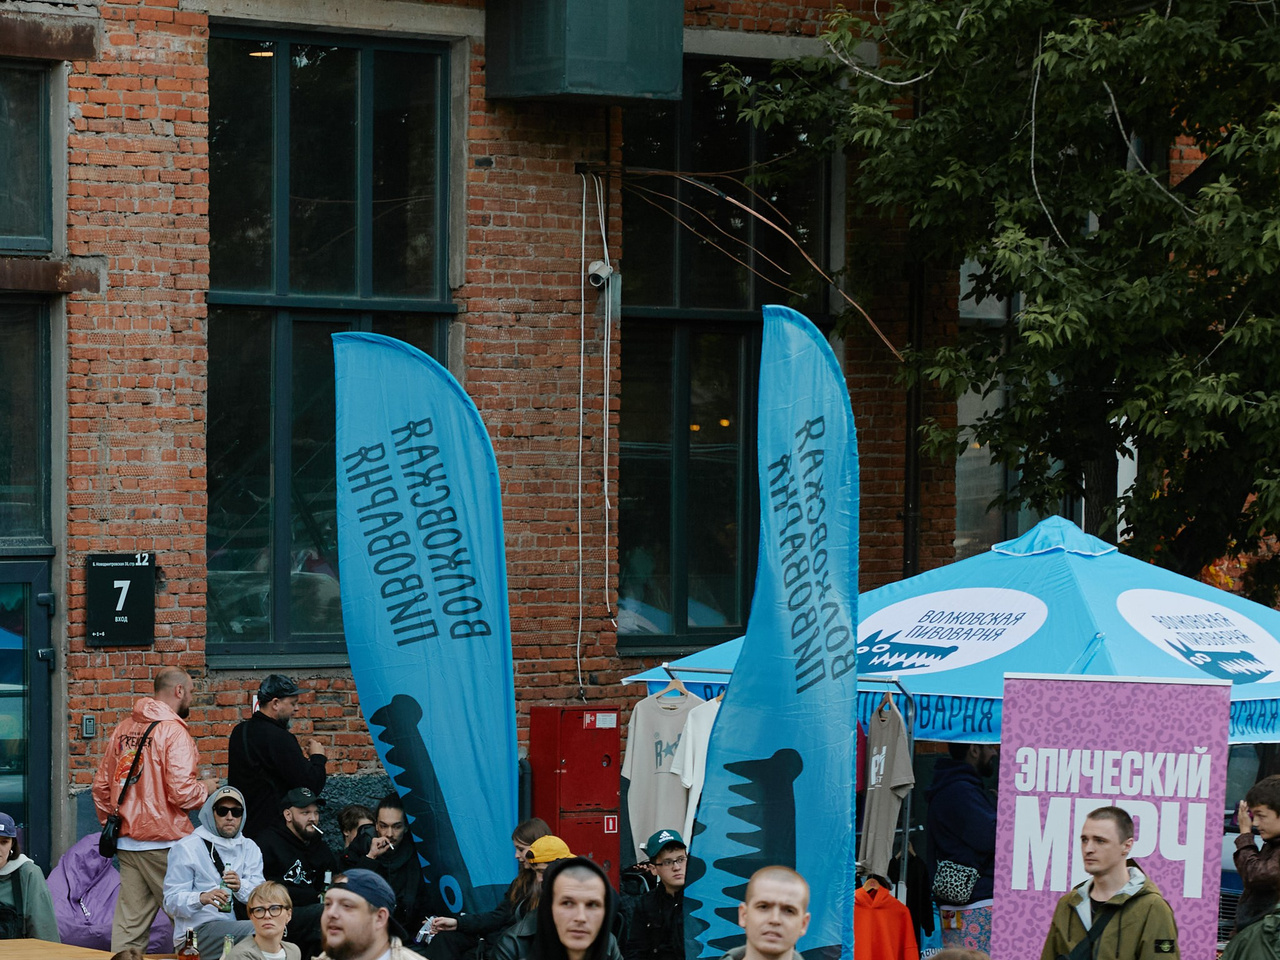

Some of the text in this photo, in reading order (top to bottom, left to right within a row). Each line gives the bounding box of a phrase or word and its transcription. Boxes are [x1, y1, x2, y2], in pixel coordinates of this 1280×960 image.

[135, 553, 149, 566] 12
[113, 580, 131, 611] 7
[918, 609, 1026, 626] ВОЛКОВСКАЯ
[905, 625, 1007, 641] ПИВОВАРНЯ
[1015, 746, 1211, 799] ЭПИЧЕСКИЙ
